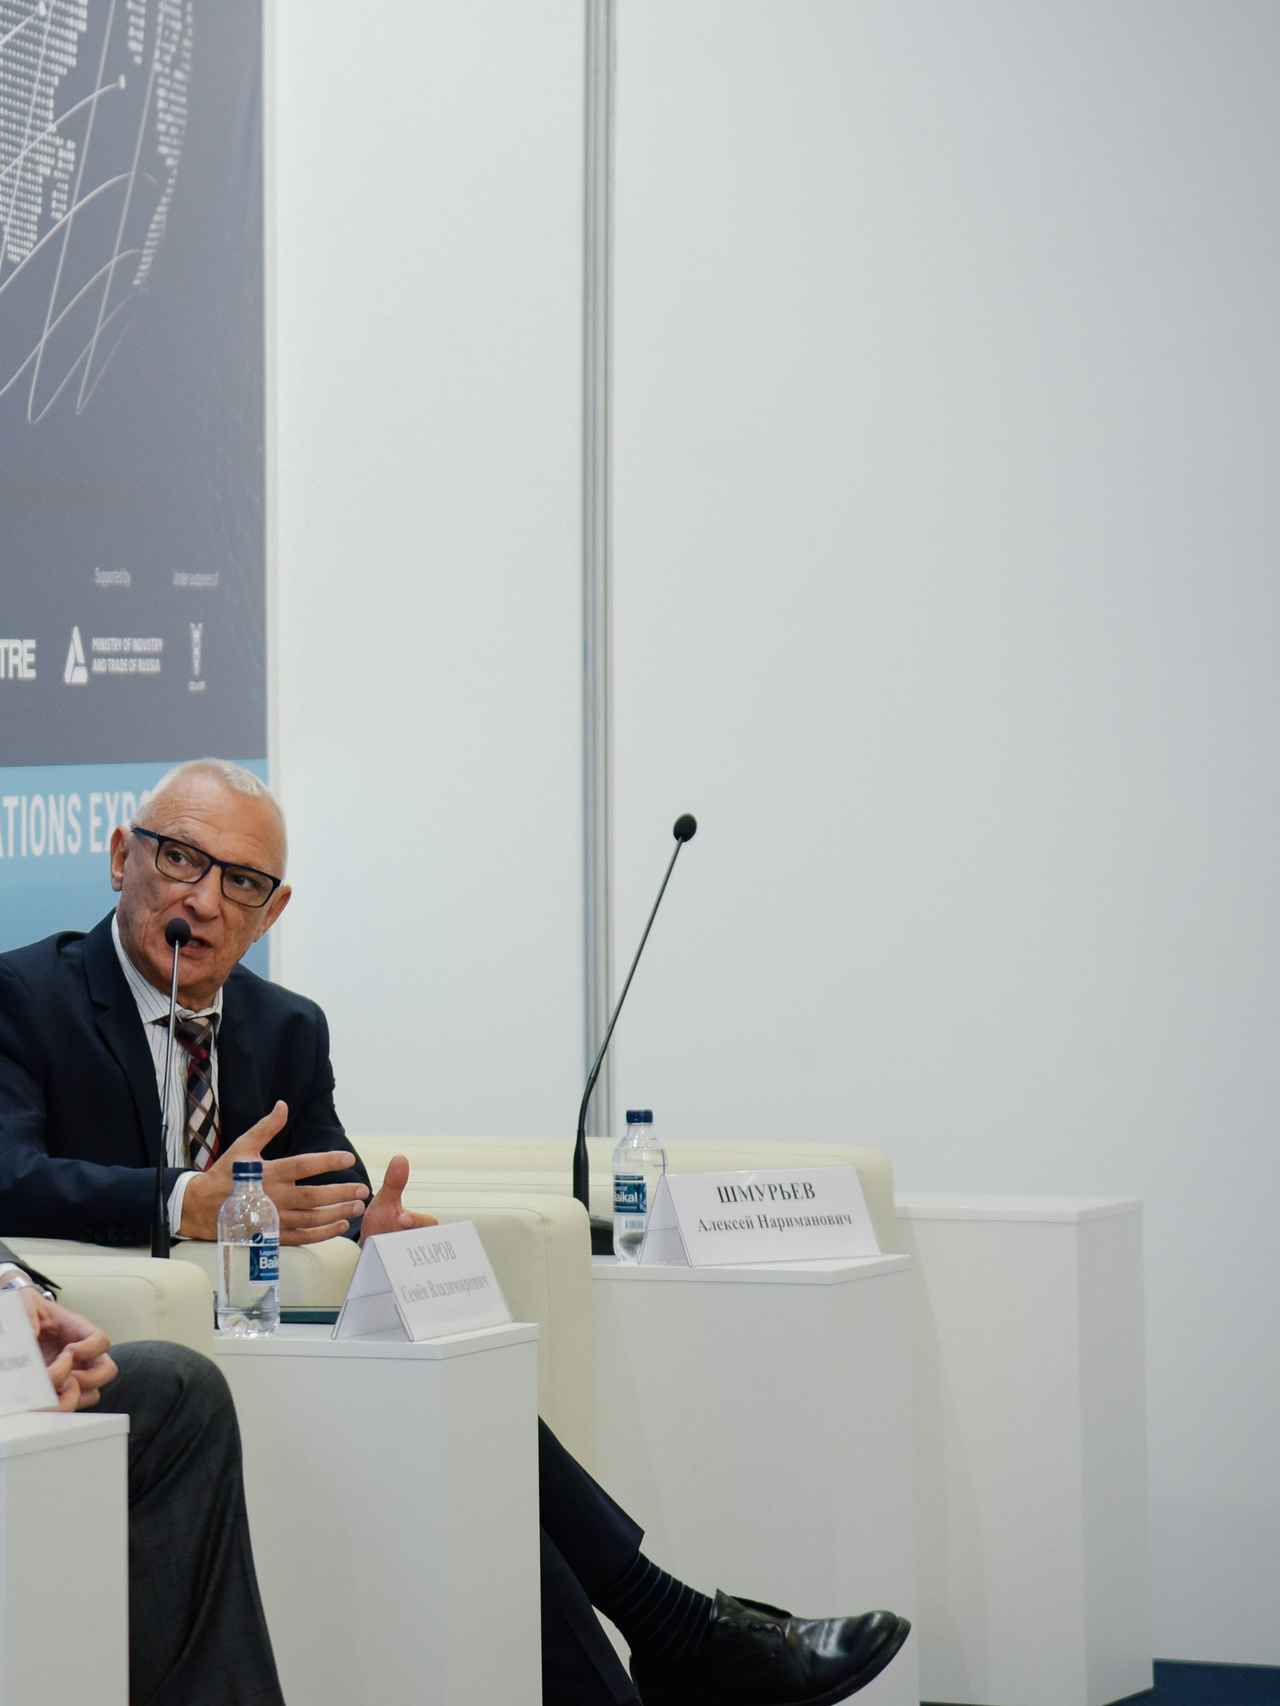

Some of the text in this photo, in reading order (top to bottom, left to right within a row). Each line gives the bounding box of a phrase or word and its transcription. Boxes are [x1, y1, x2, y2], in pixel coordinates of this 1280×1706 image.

[92, 637, 163, 652] MINISTRY OF INDUSTRY
[92, 658, 161, 672] AND TRADE OF RUSSIA
[89, 790, 151, 852] EXP
[716, 1181, 816, 1203] ШМУРЬЕВ
[698, 1213, 852, 1232] Алексей Нариманович
[406, 1241, 457, 1268] ЗАХАРОВ
